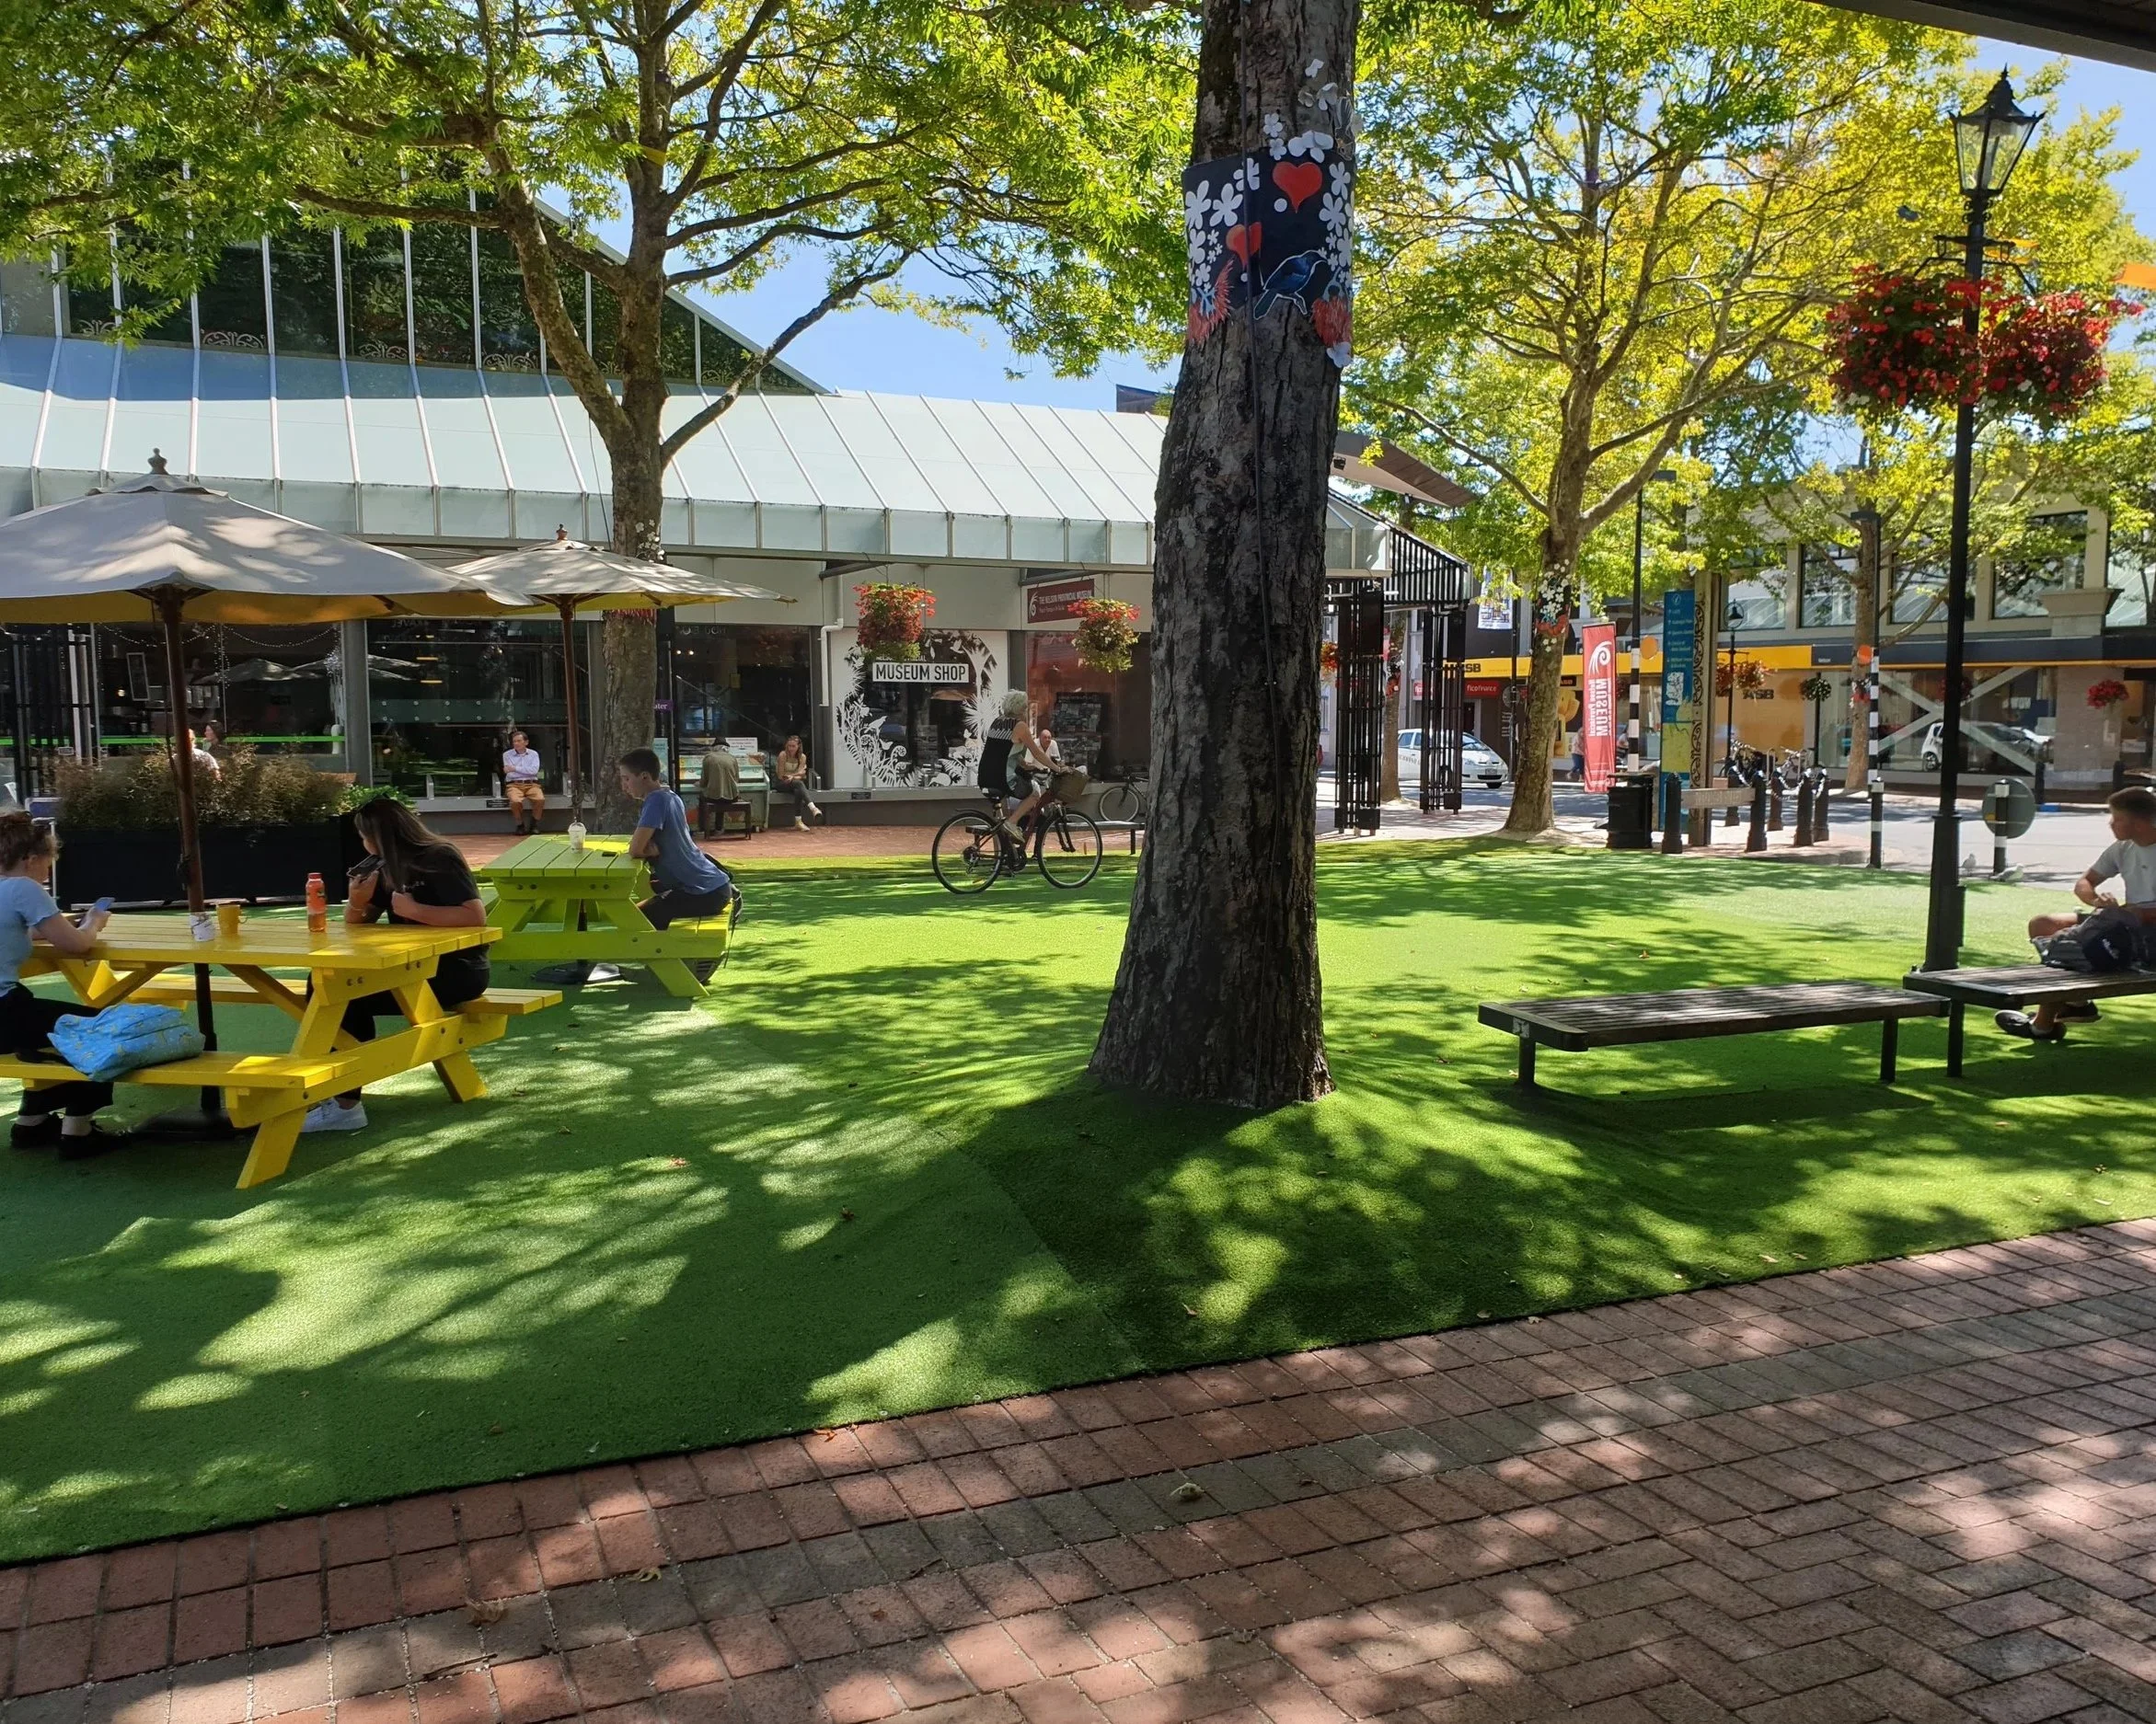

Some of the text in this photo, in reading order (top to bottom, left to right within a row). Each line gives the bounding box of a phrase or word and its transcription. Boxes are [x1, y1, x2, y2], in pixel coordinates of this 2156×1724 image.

[876, 664, 966, 681] MUSEUM SHOP
[1464, 662, 1482, 673] SB
